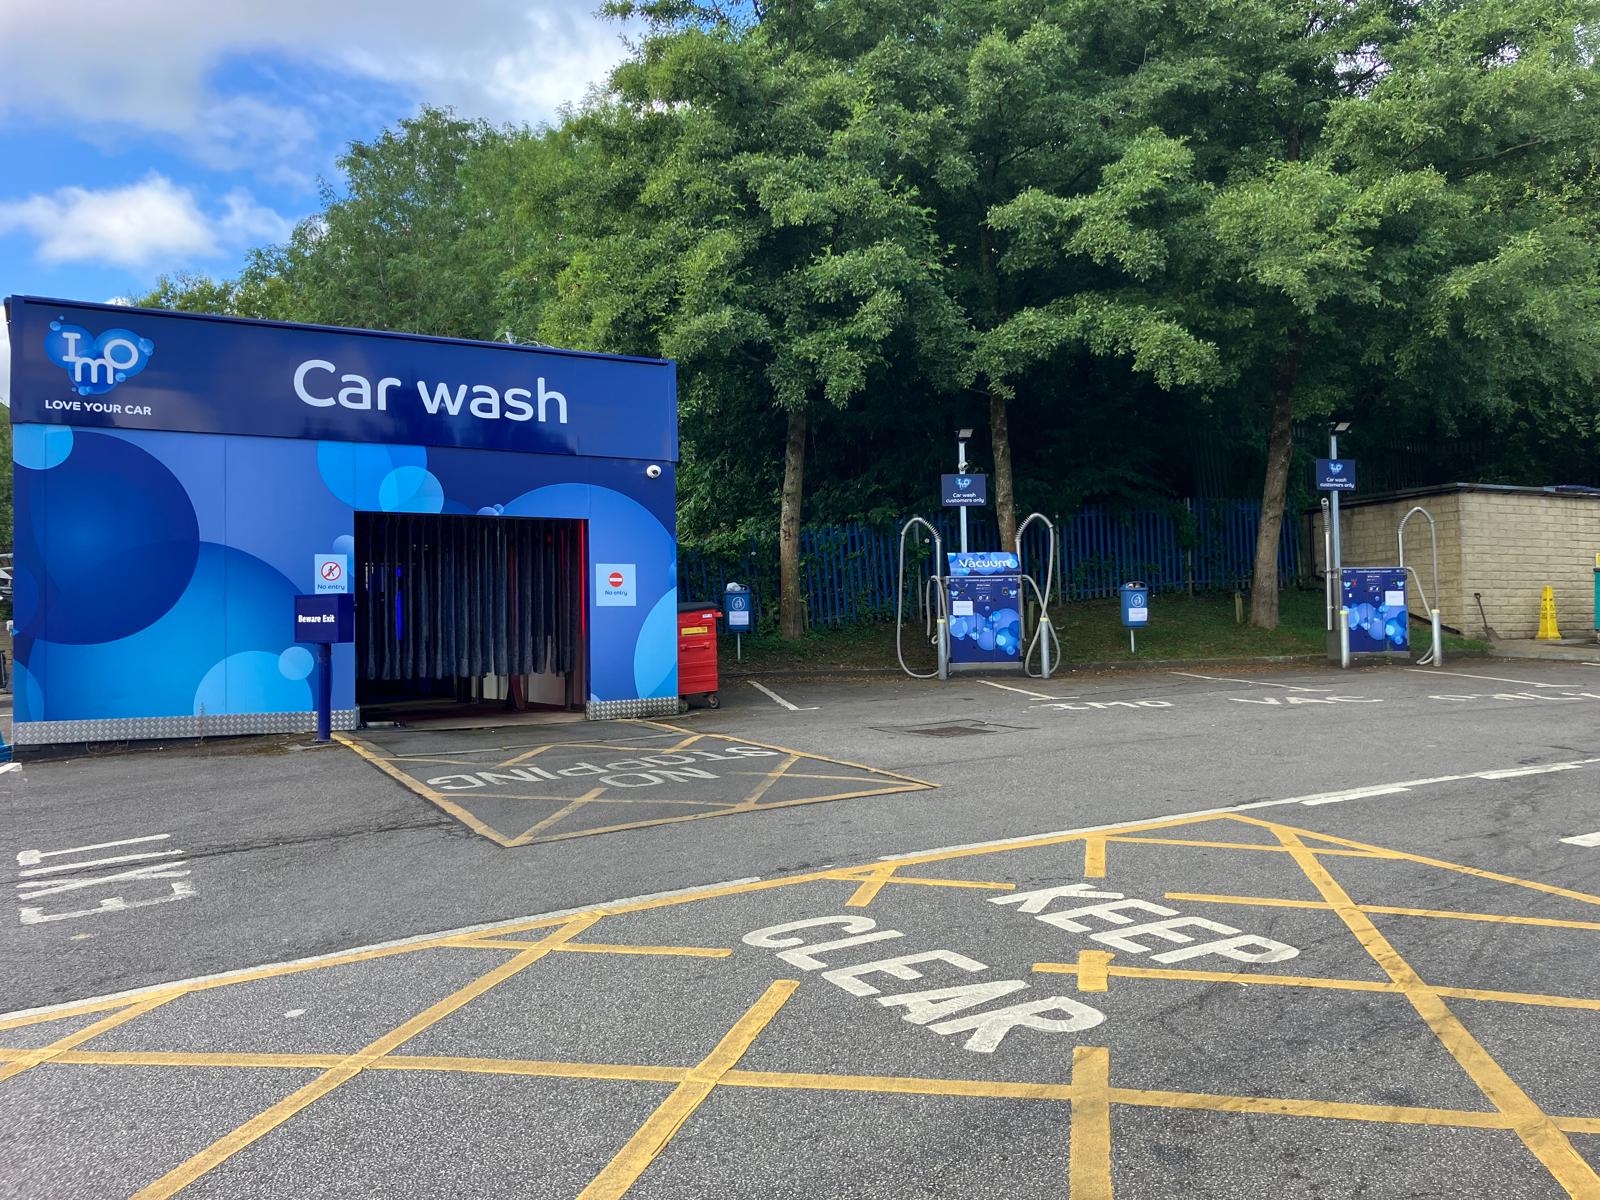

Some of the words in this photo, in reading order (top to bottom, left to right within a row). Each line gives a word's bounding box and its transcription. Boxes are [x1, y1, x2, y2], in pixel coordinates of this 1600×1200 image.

[45, 399, 81, 411] LOVE
[83, 402, 121, 414] YOUR
[124, 405, 152, 416] CAR
[293, 359, 402, 411] Car
[416, 376, 569, 424] wash
[959, 559, 1010, 568] Vacuum
[298, 614, 321, 623] Beware
[322, 614, 335, 623] Exit
[426, 746, 779, 790] STOPPING
[599, 766, 721, 788] NO
[986, 882, 1301, 965] KEEP
[742, 914, 1107, 1054] CLEAR
